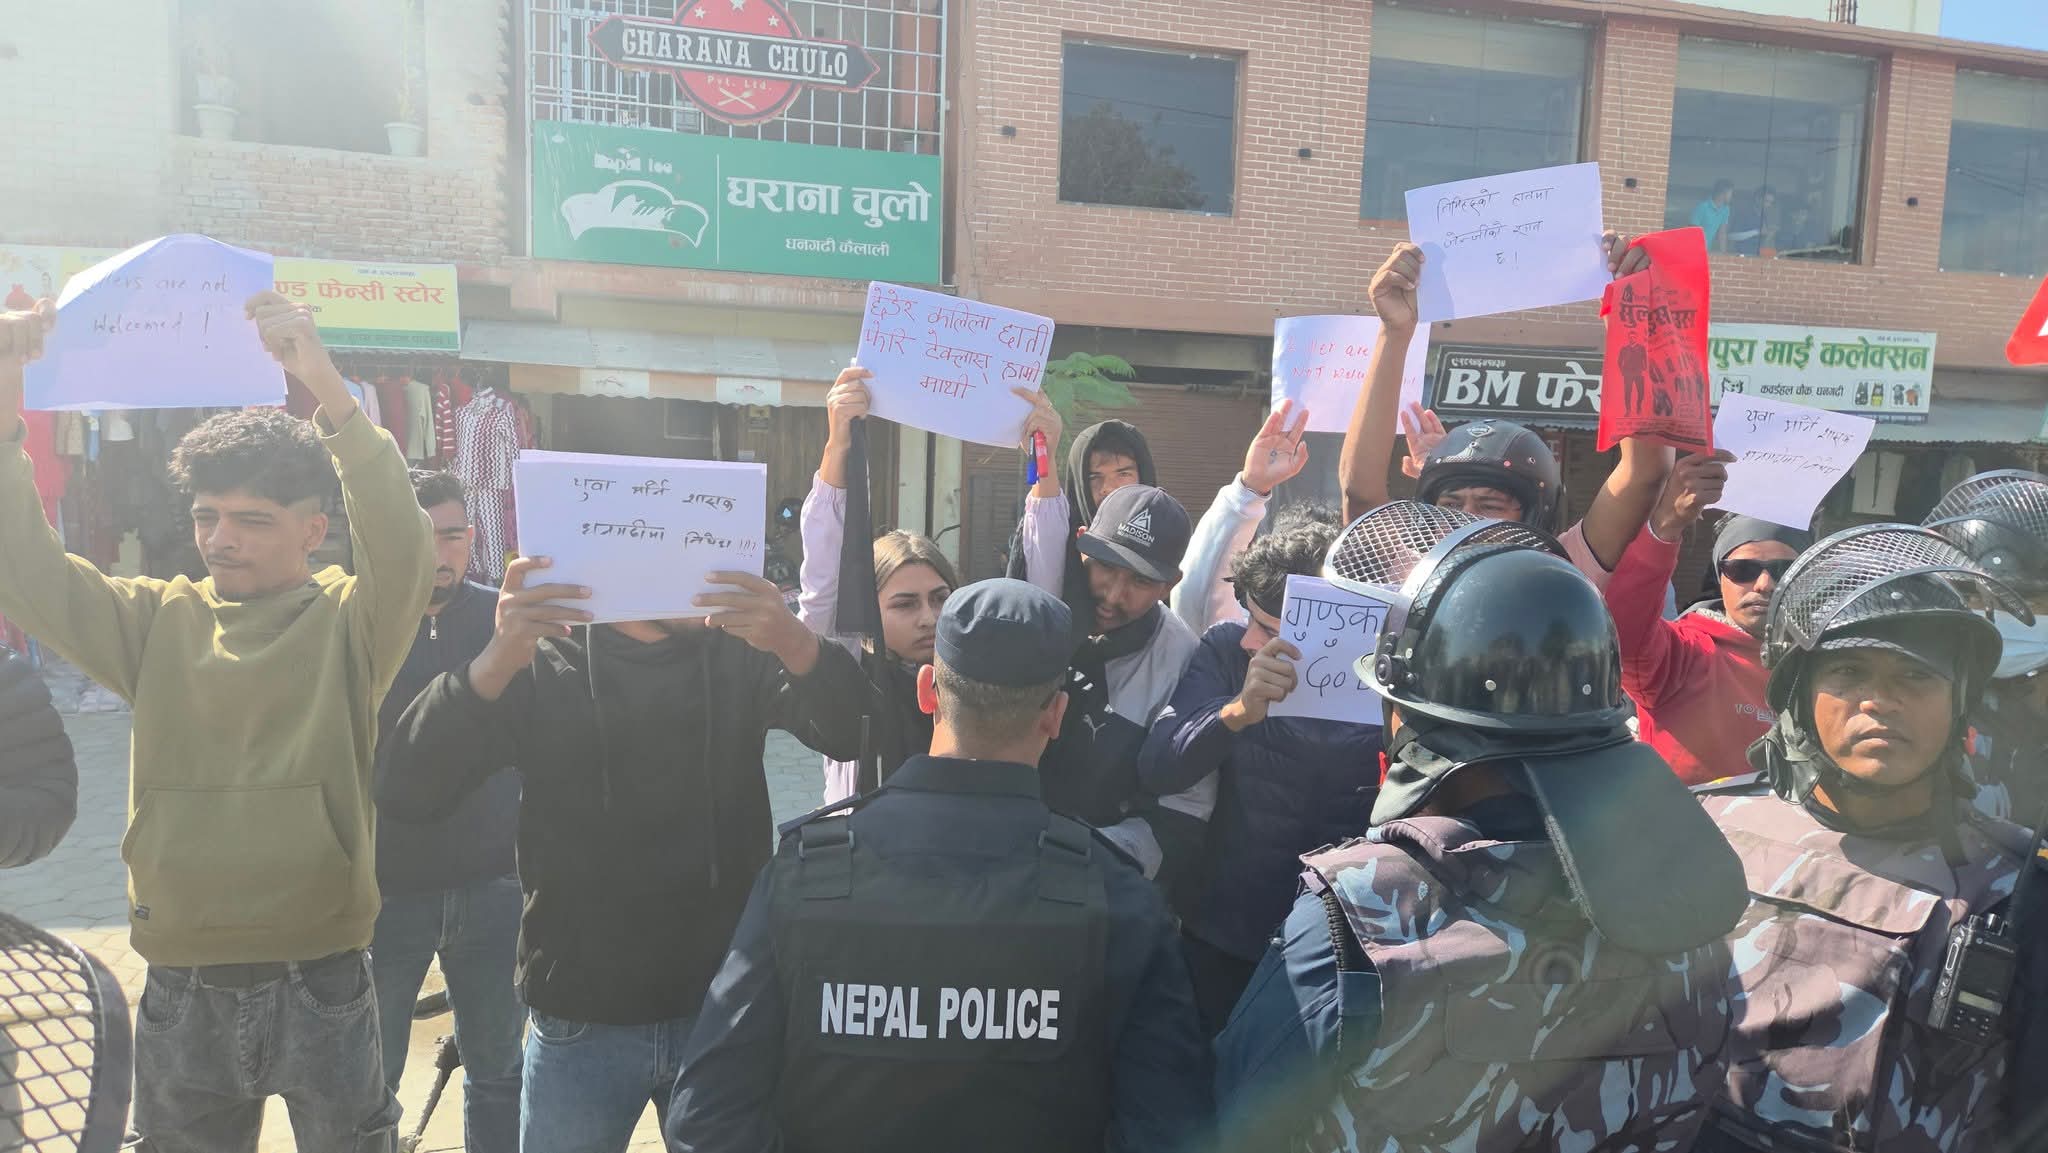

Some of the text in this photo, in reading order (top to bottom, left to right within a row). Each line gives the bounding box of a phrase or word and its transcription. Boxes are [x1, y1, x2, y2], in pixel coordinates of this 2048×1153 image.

[622, 29, 848, 77] GHARANA CHULO
[727, 176, 933, 228] घराना चुलो
[393, 281, 445, 304] स्टोर
[1764, 335, 1814, 369] माई
[1820, 335, 1930, 371] कलेक्सन
[1442, 368, 1526, 407] BM
[573, 478, 616, 502] युवा
[820, 982, 1060, 1040] NEPAL POLICE
